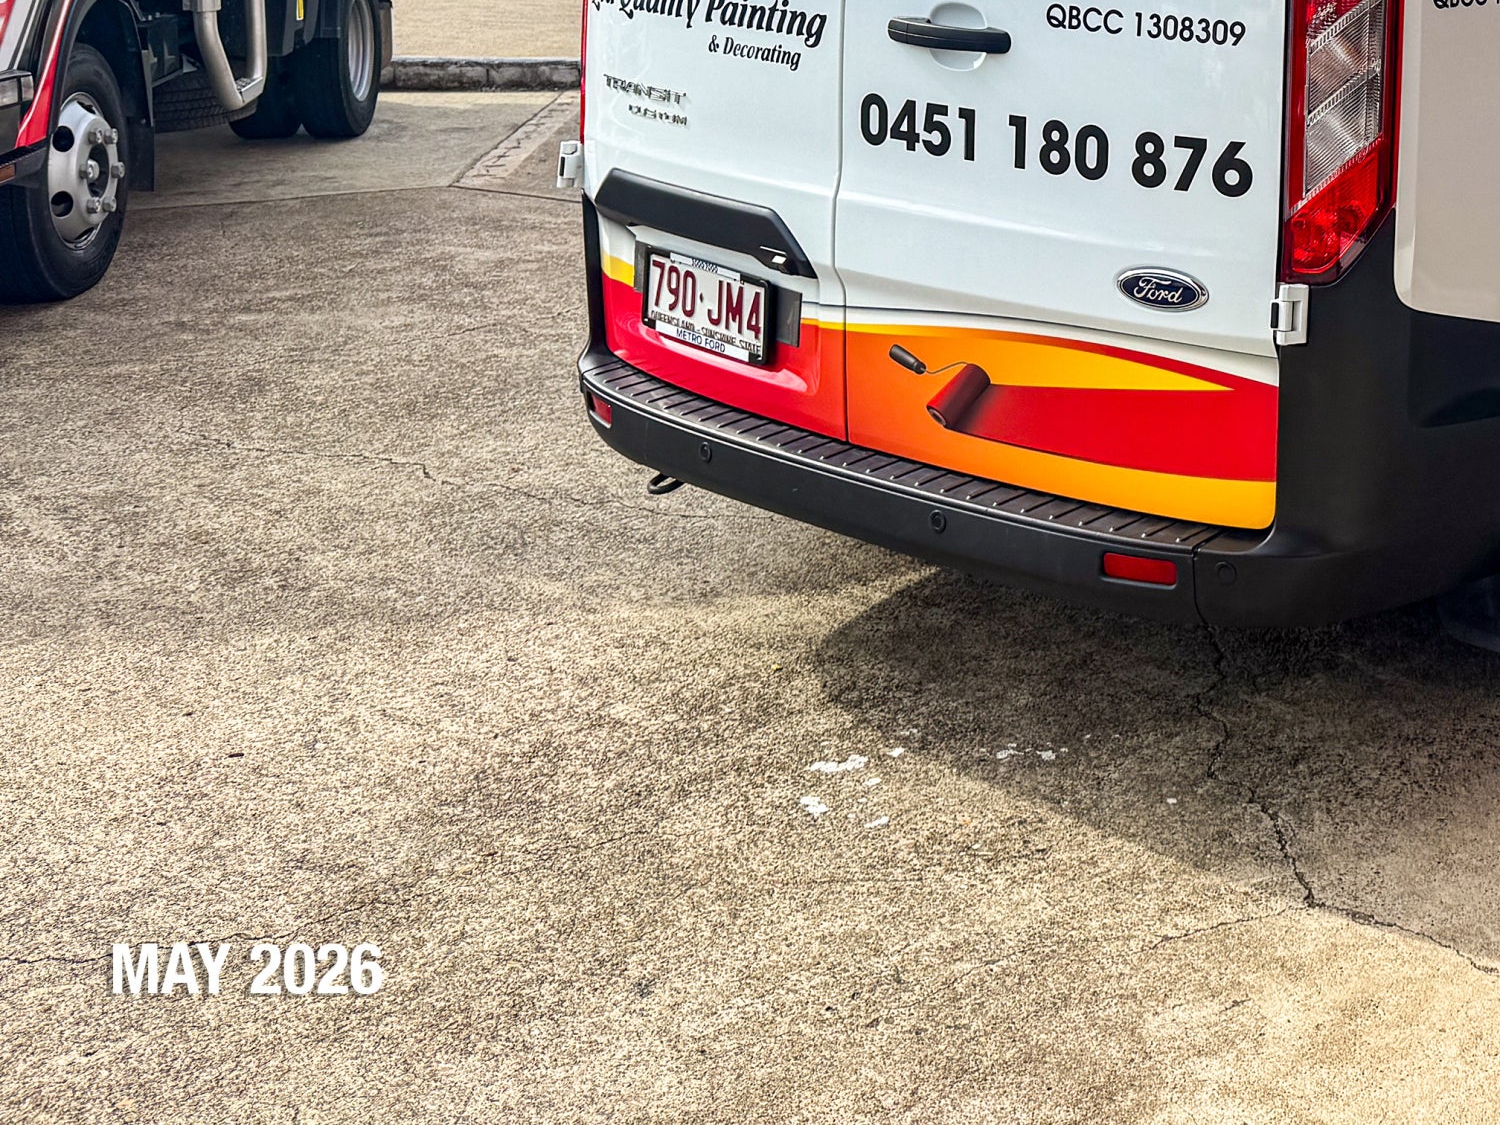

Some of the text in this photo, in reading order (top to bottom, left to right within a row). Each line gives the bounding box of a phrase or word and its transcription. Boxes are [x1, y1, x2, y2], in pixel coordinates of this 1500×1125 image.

[1046, 4, 1247, 46] QBCC 1308309
[708, 35, 801, 71] & Decorating
[603, 73, 687, 105] TRANSIT
[860, 93, 1253, 197] 0451 180 876
[1133, 276, 1184, 304] Ford
[651, 310, 695, 331] QUEENSLAND
[676, 328, 726, 353] METRO FORD
